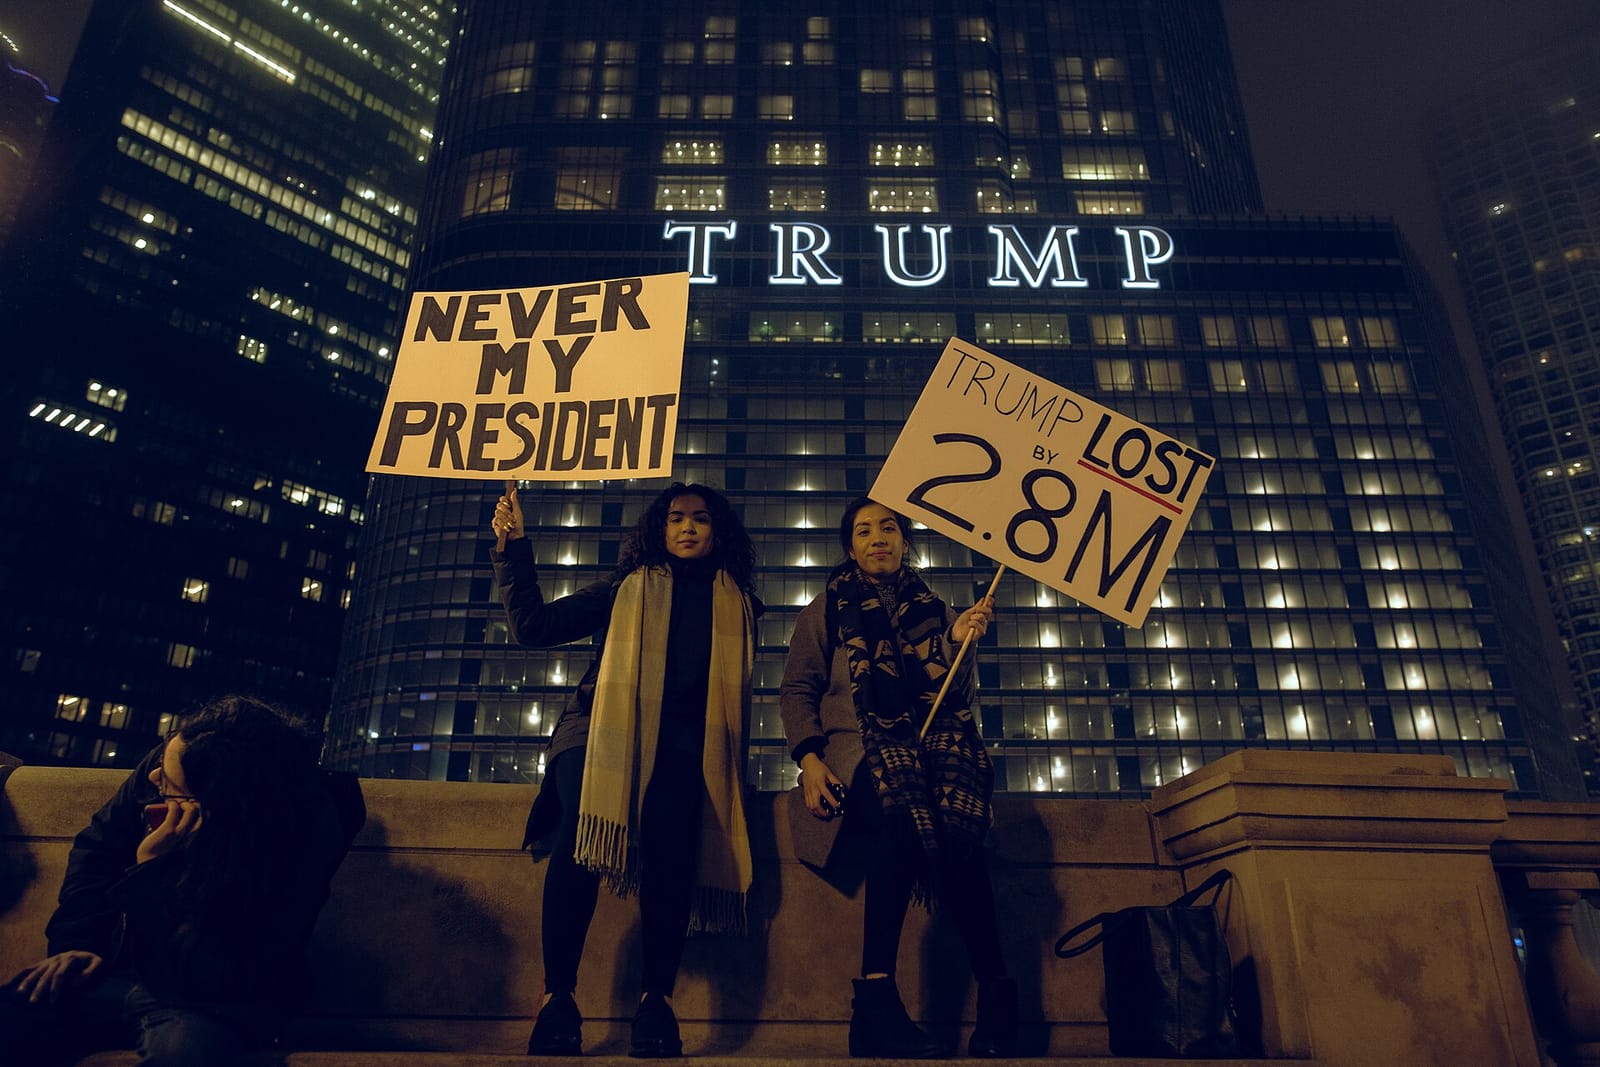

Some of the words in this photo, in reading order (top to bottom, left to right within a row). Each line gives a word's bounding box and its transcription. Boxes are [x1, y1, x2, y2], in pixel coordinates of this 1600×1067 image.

[663, 220, 1175, 289] TRUMP
[413, 278, 651, 342] NEVER
[475, 336, 594, 395] MY
[379, 393, 677, 471] PRESIDENT
[945, 348, 1084, 437] TRUMP
[1082, 413, 1214, 503] LOST
[1032, 445, 1059, 465] BY
[906, 433, 1173, 613] 2.8M
